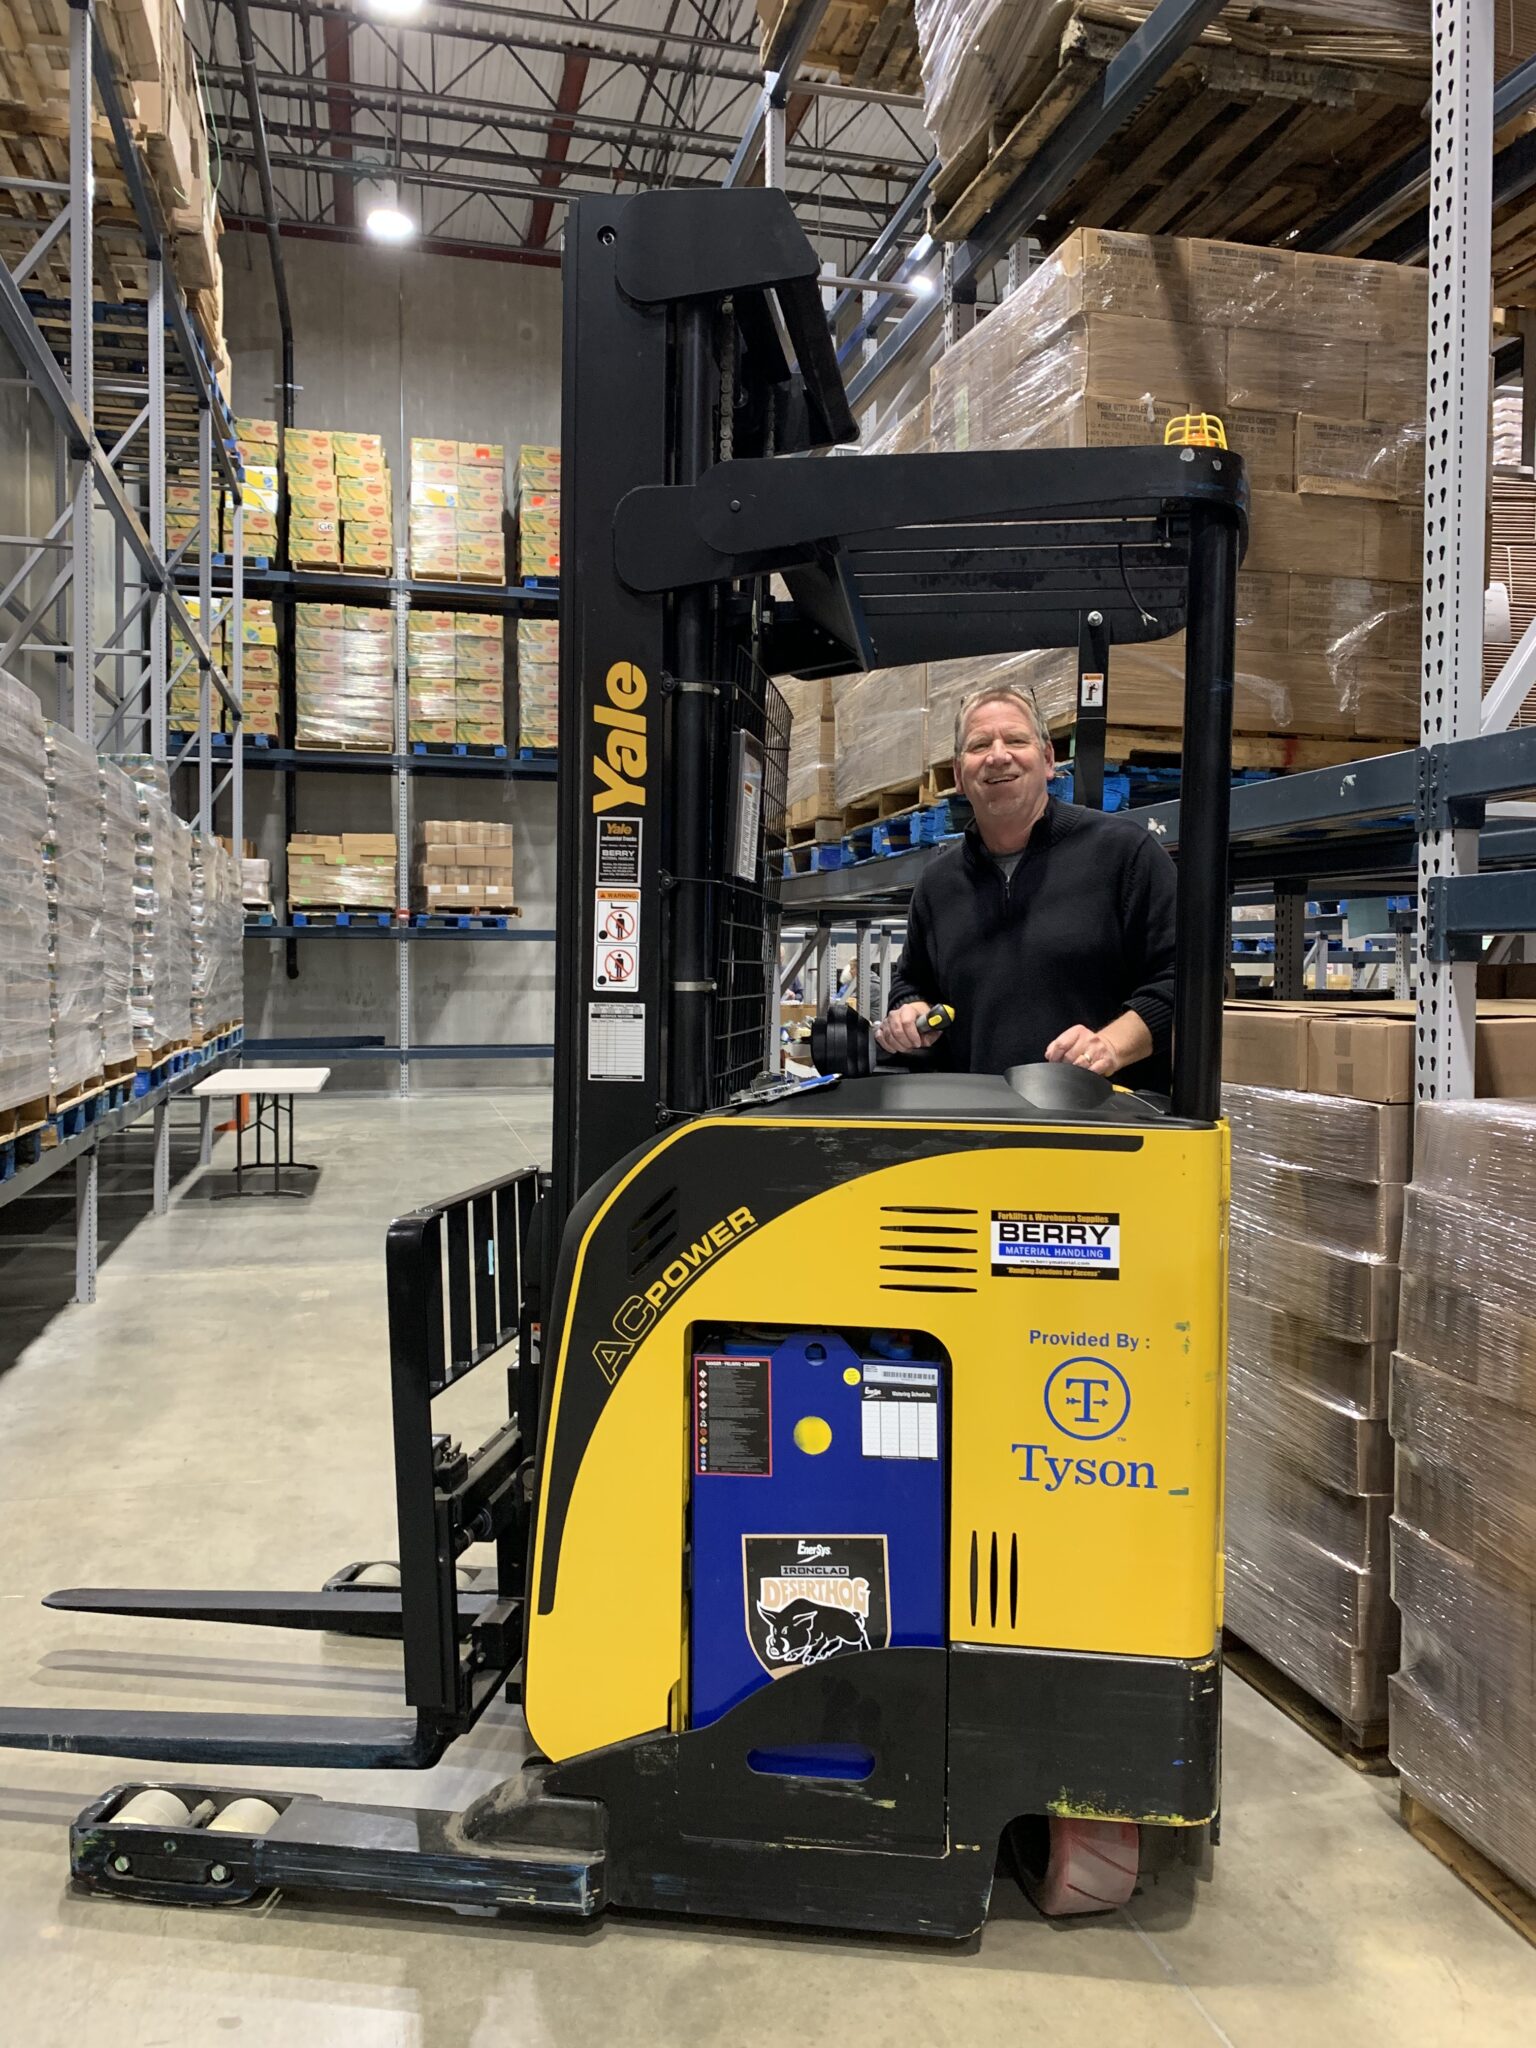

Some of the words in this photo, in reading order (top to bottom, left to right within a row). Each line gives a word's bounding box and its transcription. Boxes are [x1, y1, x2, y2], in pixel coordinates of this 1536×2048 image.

[593, 661, 648, 814] Yale
[607, 823, 633, 835] Yale
[1035, 1213, 1076, 1223] Warehouse
[1077, 1215, 1109, 1224] Supplies
[999, 1223, 1110, 1245] BERRY
[1005, 1246, 1051, 1256] MATERIAL
[1054, 1248, 1104, 1258] HANDLING
[1029, 1330, 1109, 1347] Provided
[1011, 1443, 1158, 1492] Tyson
[797, 1540, 832, 1557] EnerSys
[782, 1567, 848, 1575] IRONCLAD
[761, 1577, 871, 1618] DESERTHOG
